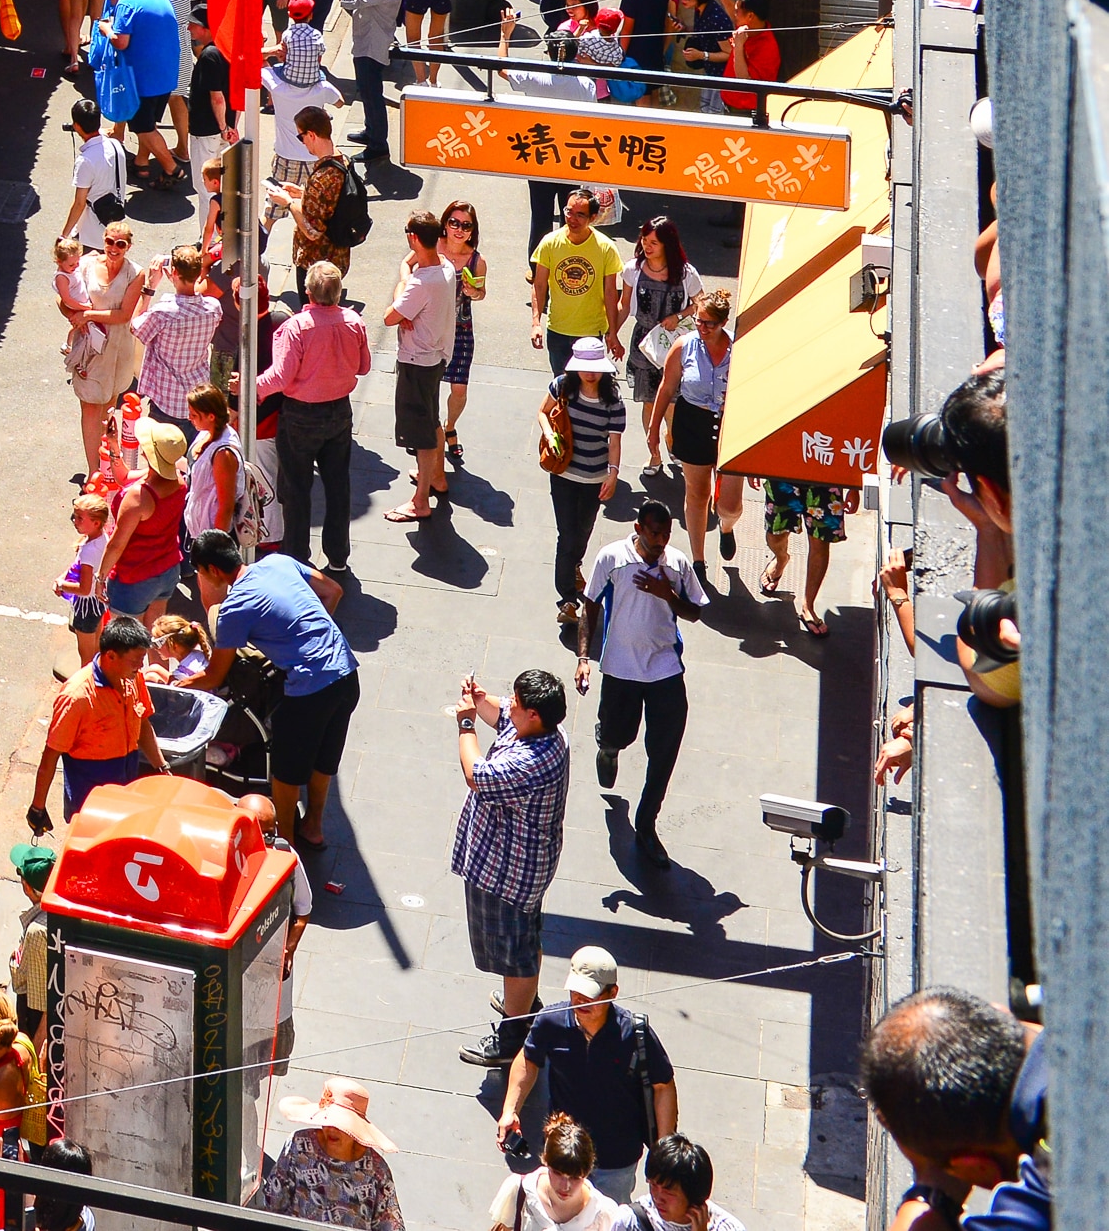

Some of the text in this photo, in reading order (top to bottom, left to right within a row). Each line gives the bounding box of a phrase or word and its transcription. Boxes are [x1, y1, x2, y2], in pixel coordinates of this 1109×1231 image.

[506, 122, 667, 174] 精武鴨
[802, 431, 874, 472] 陽光
